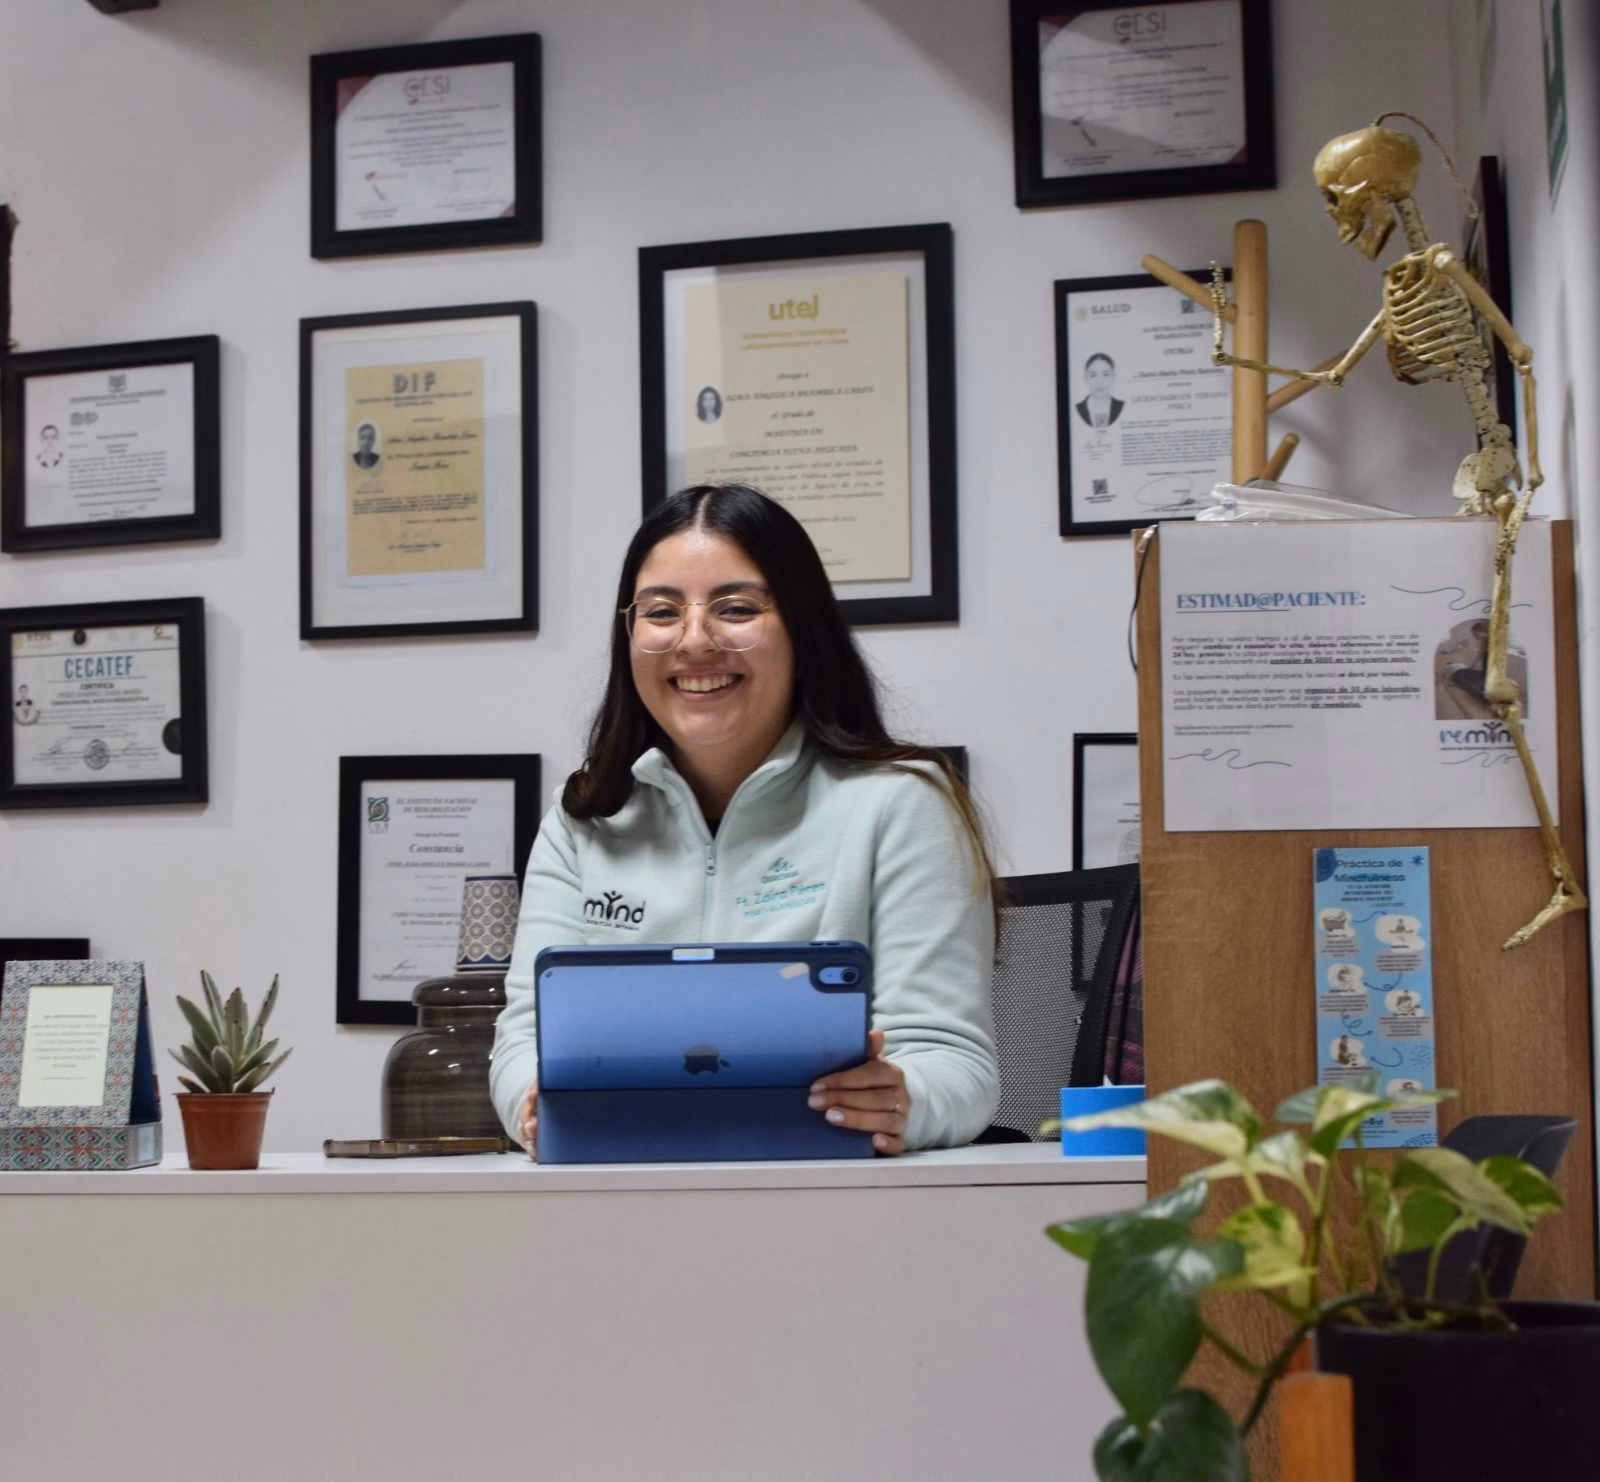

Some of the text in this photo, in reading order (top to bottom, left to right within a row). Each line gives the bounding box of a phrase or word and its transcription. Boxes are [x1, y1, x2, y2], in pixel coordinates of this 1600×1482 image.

[768, 293, 820, 321] utel
[1091, 303, 1131, 315] SALUD
[393, 370, 437, 394] DIF
[1177, 591, 1366, 609] ESTIMAD@PACIENTE:
[64, 655, 134, 679] CECATEF
[408, 843, 465, 854] Constancia
[1336, 858, 1403, 868] Práctica de
[1334, 873, 1406, 882] Mindfulness
